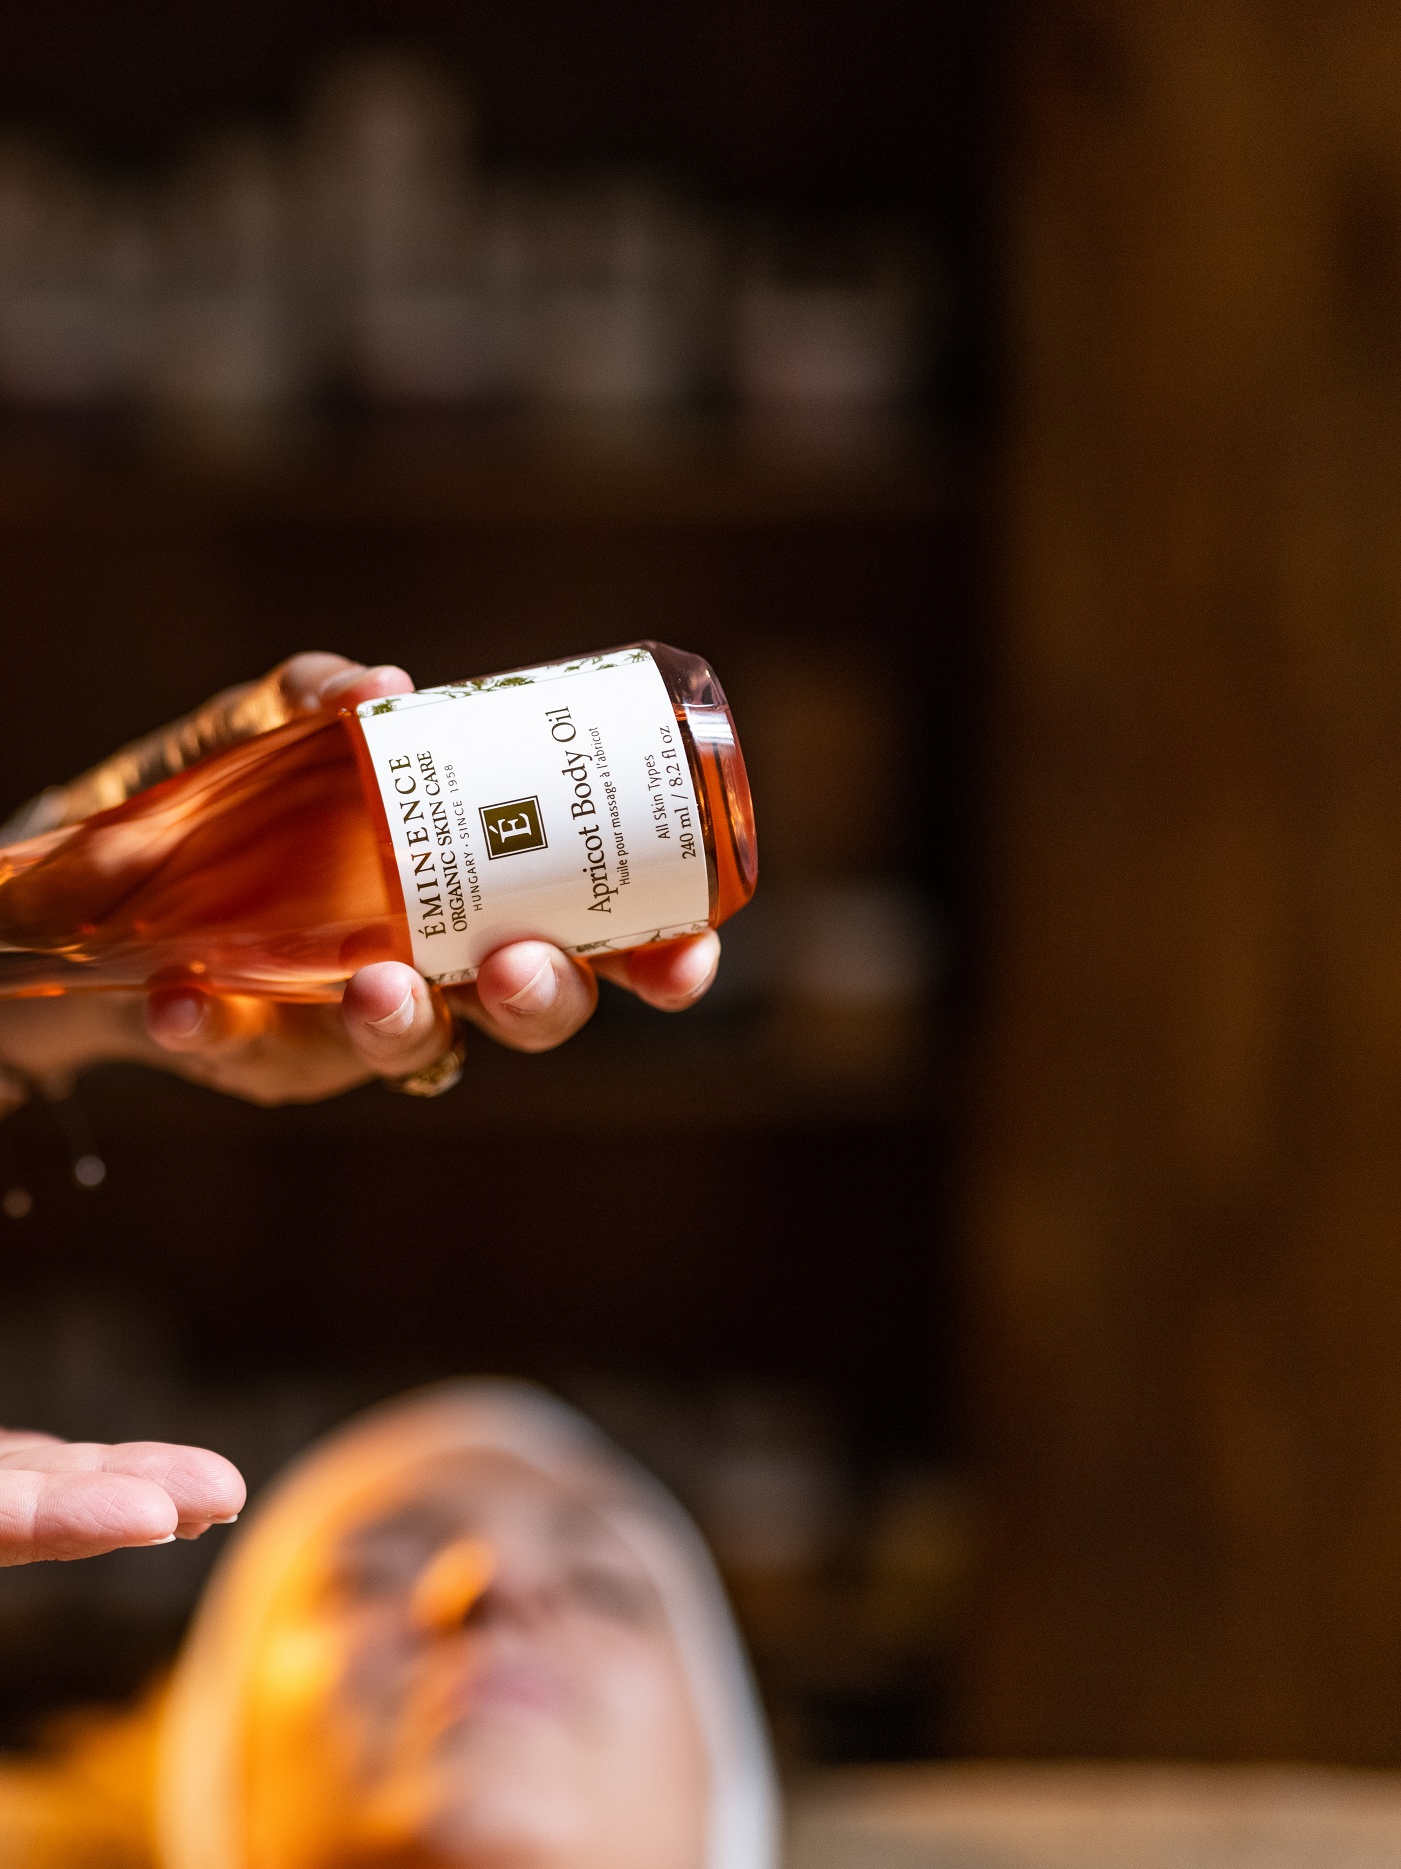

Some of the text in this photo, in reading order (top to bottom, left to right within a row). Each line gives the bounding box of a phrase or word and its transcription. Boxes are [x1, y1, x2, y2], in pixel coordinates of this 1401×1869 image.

[588, 727, 608, 769] l'abricot
[659, 725, 673, 744] oz
[661, 748, 677, 759] fl
[665, 762, 684, 787] 8.2
[544, 706, 619, 914] Apricot Body Oil
[603, 780, 622, 829] massage
[644, 754, 671, 839] All Skin Types
[489, 812, 532, 844] É
[674, 806, 692, 829] ml
[388, 755, 447, 939] ÉMINENCE
[416, 750, 468, 932] ORGANIC SKIN CARE
[444, 764, 483, 912] HUNGARY SINCE 1958
[613, 832, 629, 857] pour
[679, 833, 696, 859] 240
[616, 859, 631, 886] Huile
